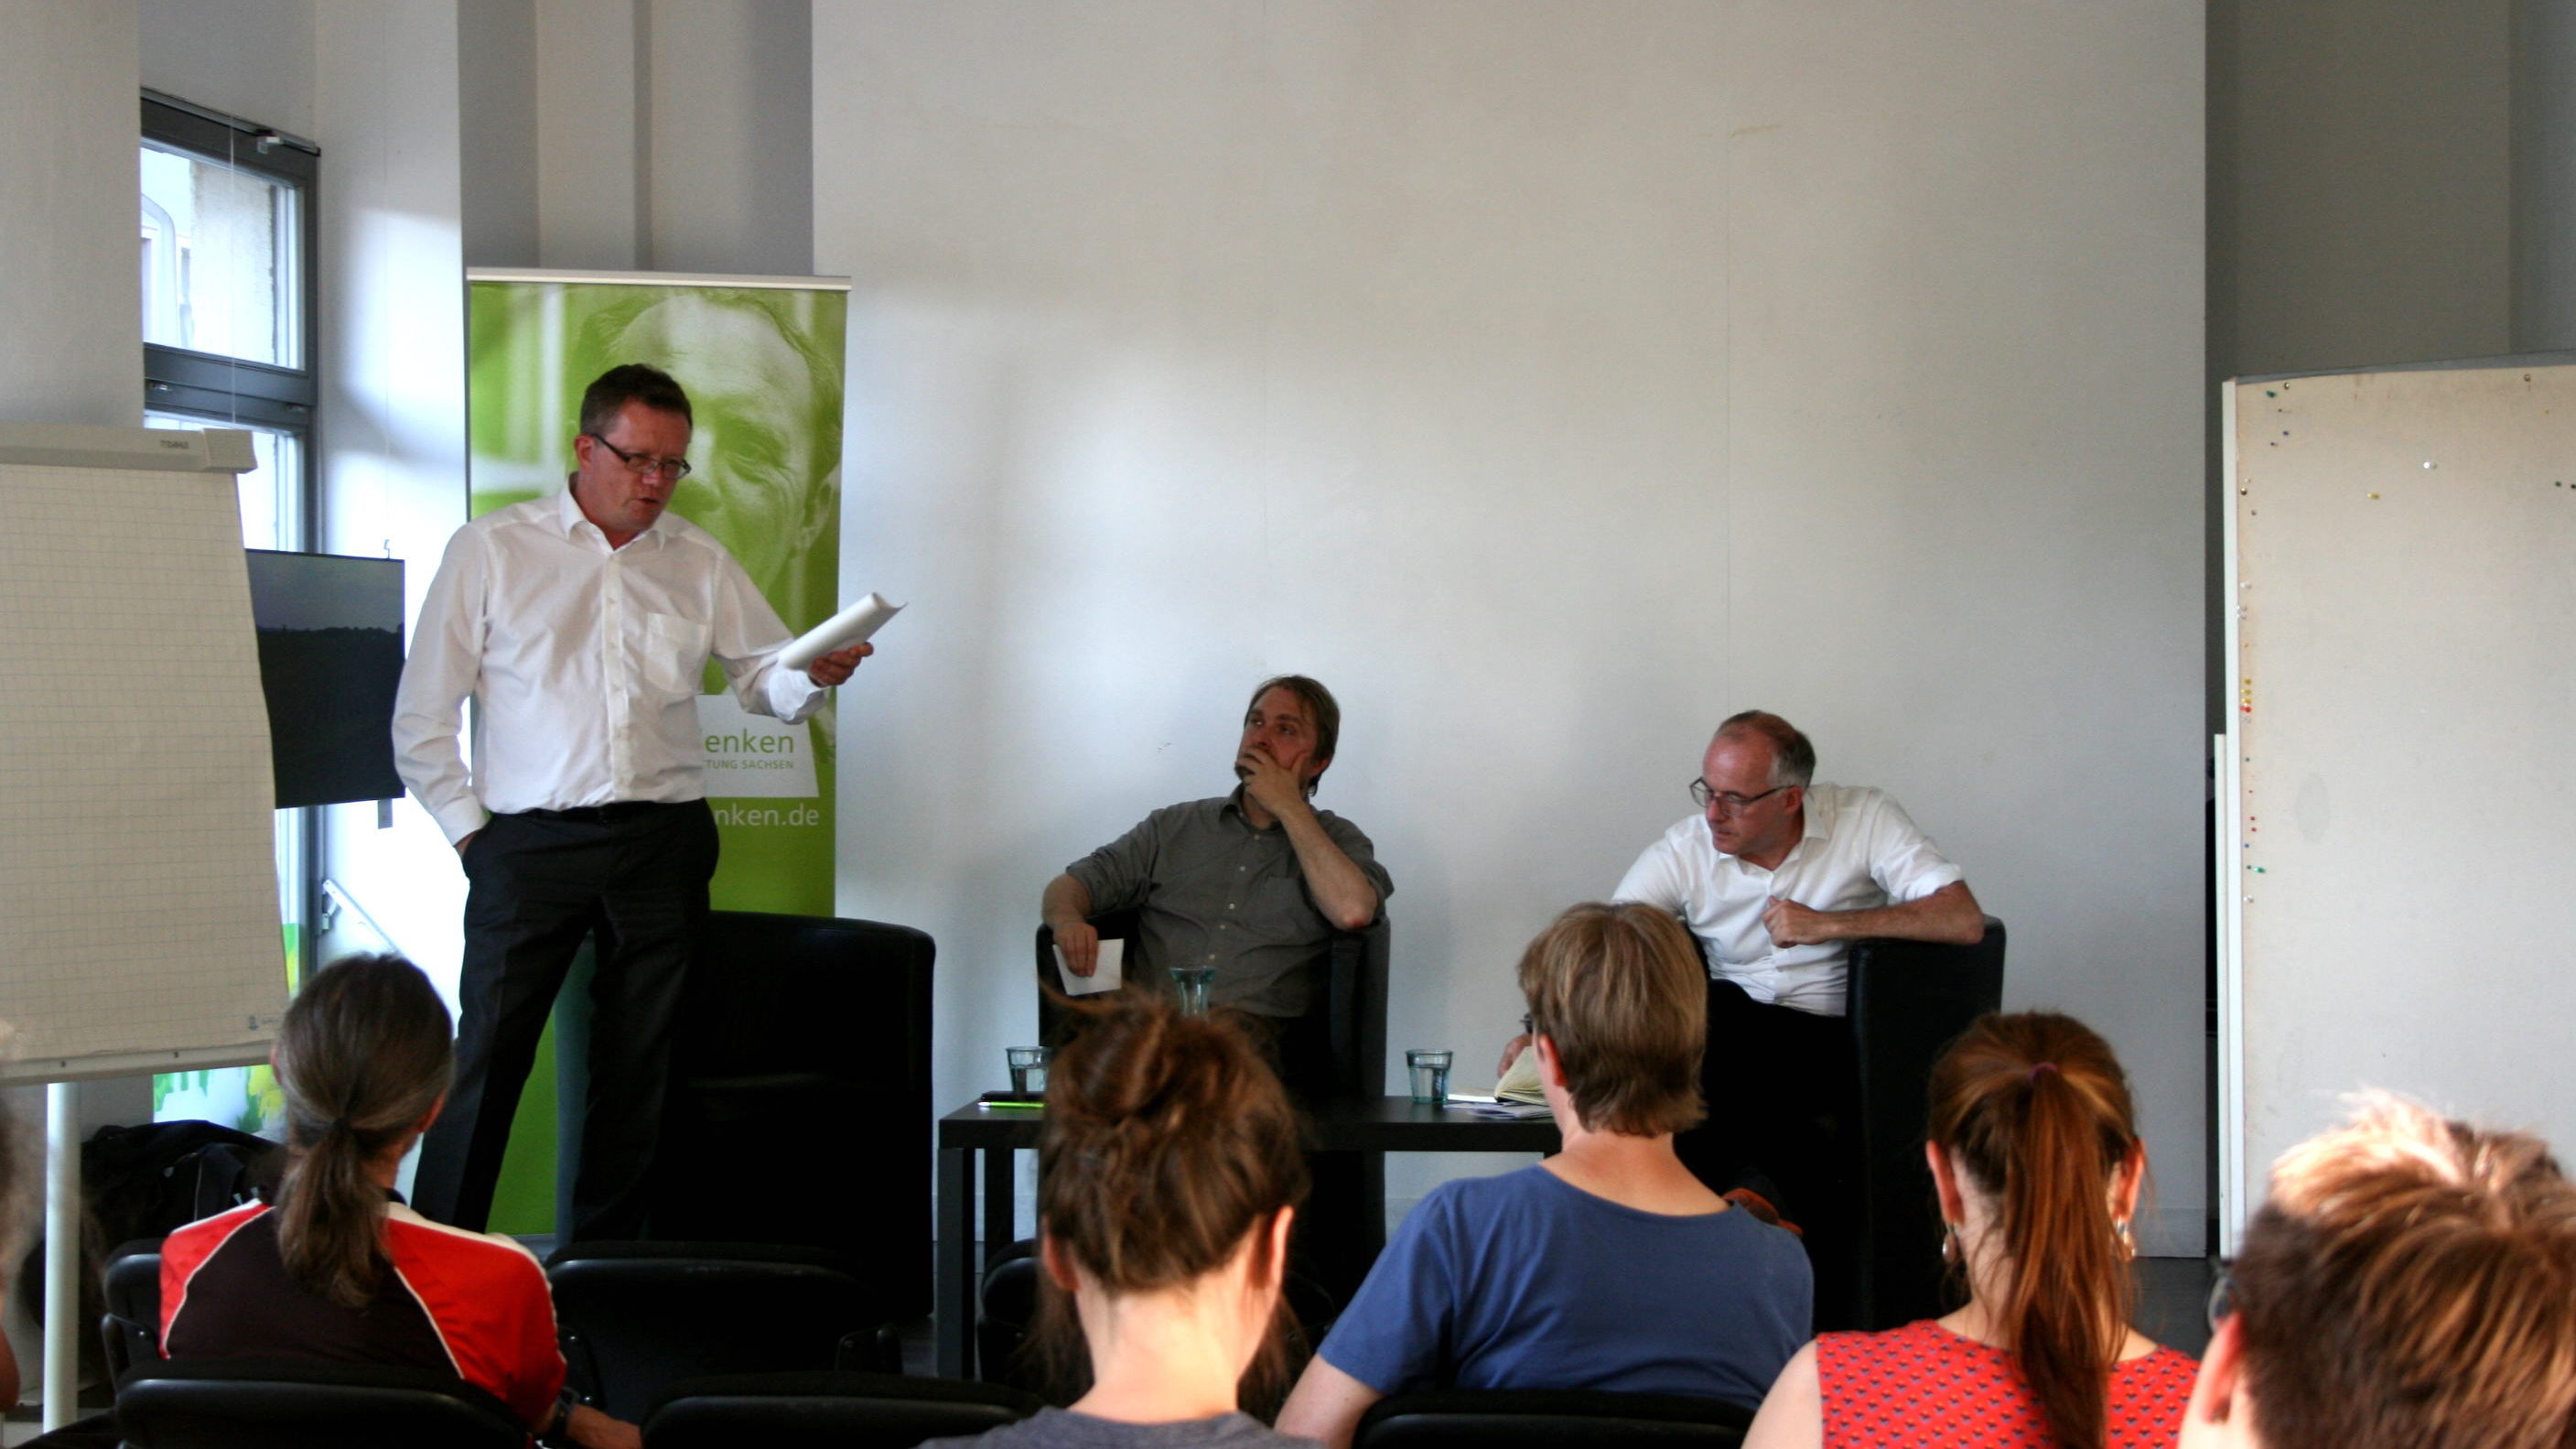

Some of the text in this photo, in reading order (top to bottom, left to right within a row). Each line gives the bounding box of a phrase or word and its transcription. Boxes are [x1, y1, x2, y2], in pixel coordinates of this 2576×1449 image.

[705, 729, 794, 753] enken
[703, 760, 794, 770] TUNG SACHSEN
[714, 803, 820, 827] nken.de
